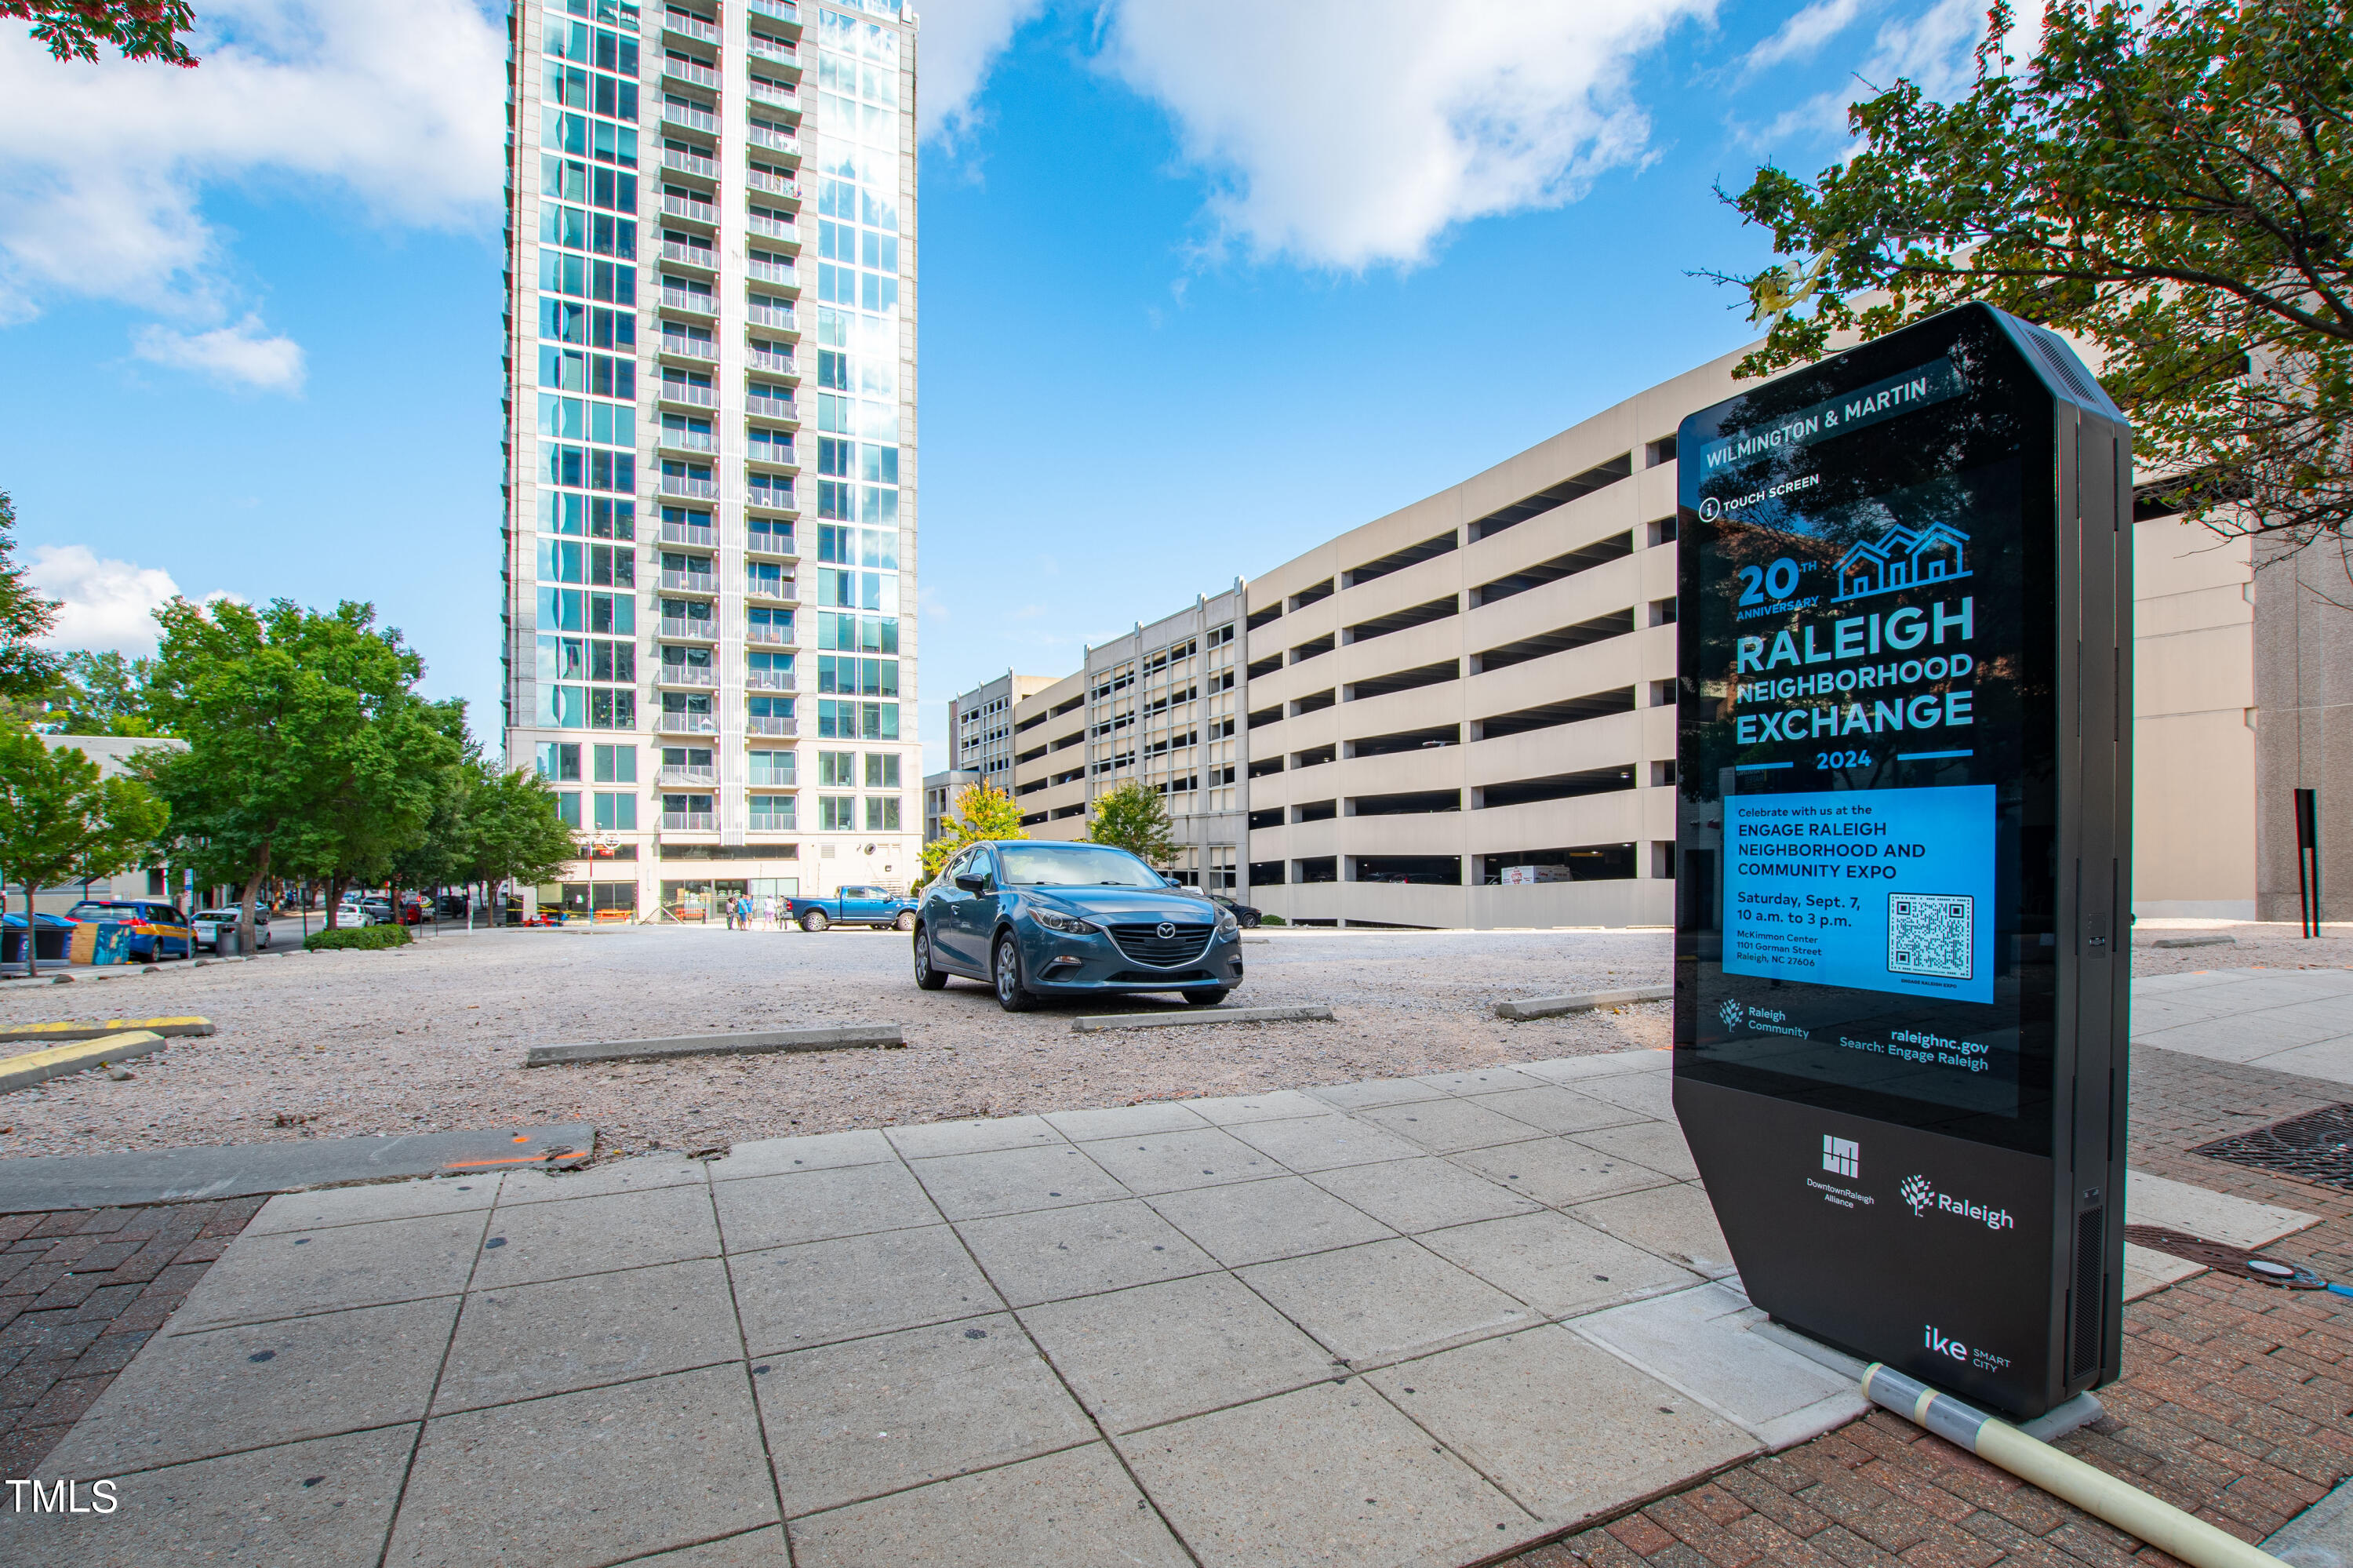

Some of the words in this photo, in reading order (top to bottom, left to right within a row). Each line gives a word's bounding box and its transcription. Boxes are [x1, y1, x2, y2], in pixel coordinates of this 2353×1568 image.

[1707, 416, 1819, 468] WILMINGTON
[1824, 410, 1839, 428] &
[1845, 377, 1926, 422] MARTIN
[1723, 491, 1765, 512] TOUCH
[1769, 474, 1820, 498] SCREEN
[1737, 595, 1819, 622] ANNIVERSARY
[1737, 596, 1973, 674] RALEIGH
[1737, 653, 1973, 704] NEIGHBORHOOD
[1737, 690, 1973, 744] EXCHANGE
[1817, 749, 1872, 769] 2024
[1738, 808, 1788, 817] Celebrate
[1791, 806, 1817, 816] with
[1820, 806, 1833, 815] us
[1835, 806, 1848, 815] at
[1851, 804, 1872, 814] the
[1739, 824, 1804, 836] ENGAGE
[1809, 822, 1887, 836] RALEIGH
[1738, 843, 1878, 857] NEIGHBORHOOD
[1883, 843, 1926, 858] AND
[1738, 863, 1841, 877] COMMUNITY
[1846, 865, 1897, 879] EXPO
[1737, 891, 1801, 908] Saturday,
[1806, 894, 1846, 911] Sept.
[1849, 897, 1861, 911] 7,
[1737, 909, 1752, 920] 10
[1755, 912, 1784, 923] a.m.
[1788, 912, 1803, 924] to
[1807, 913, 1816, 925] 3
[1820, 916, 1852, 929] p.m.
[1737, 930, 1785, 941] McKimmon
[1787, 933, 1818, 944] Center
[1737, 941, 1754, 950] 1101
[1755, 942, 1790, 953] Gorman
[1792, 946, 1822, 956] Street
[1737, 951, 1769, 964] Raleigh,
[1772, 955, 1785, 964] NC
[1787, 957, 1815, 967] 27606
[1748, 1006, 1786, 1023] Raleigh
[1748, 1020, 1809, 1040] Community
[1891, 1029, 1989, 1055] raleighnc.gov
[1839, 1036, 1885, 1053] Search:
[1888, 1044, 1934, 1064] Engage
[1938, 1052, 1988, 1072] Raleigh
[1806, 1177, 1875, 1205] DowntownRaleigh
[1824, 1193, 1854, 1209] Alliance
[1938, 1194, 2014, 1230] Raleigh
[1924, 1324, 1968, 1361] ike
[1973, 1348, 2012, 1368] SMART
[1973, 1358, 1998, 1373] CITY
